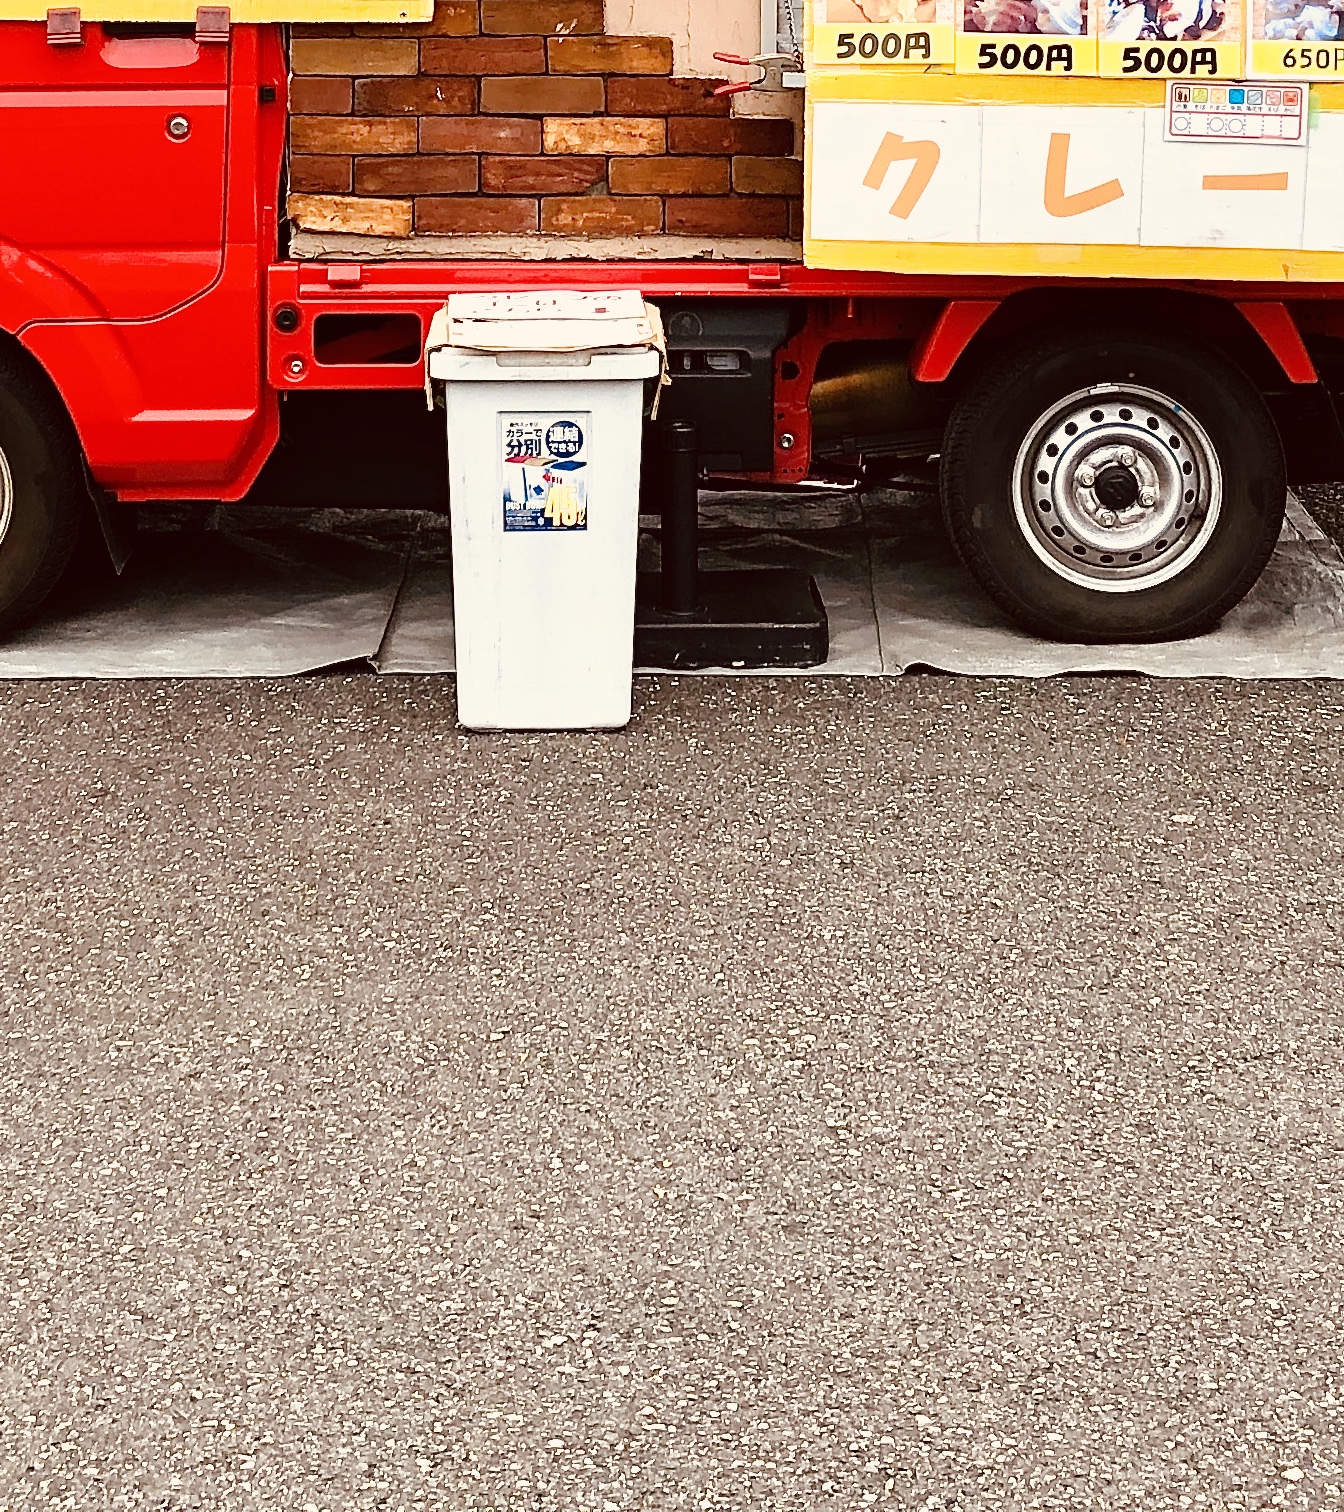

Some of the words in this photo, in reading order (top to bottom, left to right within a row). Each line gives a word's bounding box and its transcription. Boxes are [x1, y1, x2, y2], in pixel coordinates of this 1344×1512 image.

[836, 32, 931, 59] 500円
[977, 43, 1073, 71] 500円
[1122, 47, 1217, 75] 500円
[506, 429, 542, 438] カラーで
[506, 438, 542, 457] 分別
